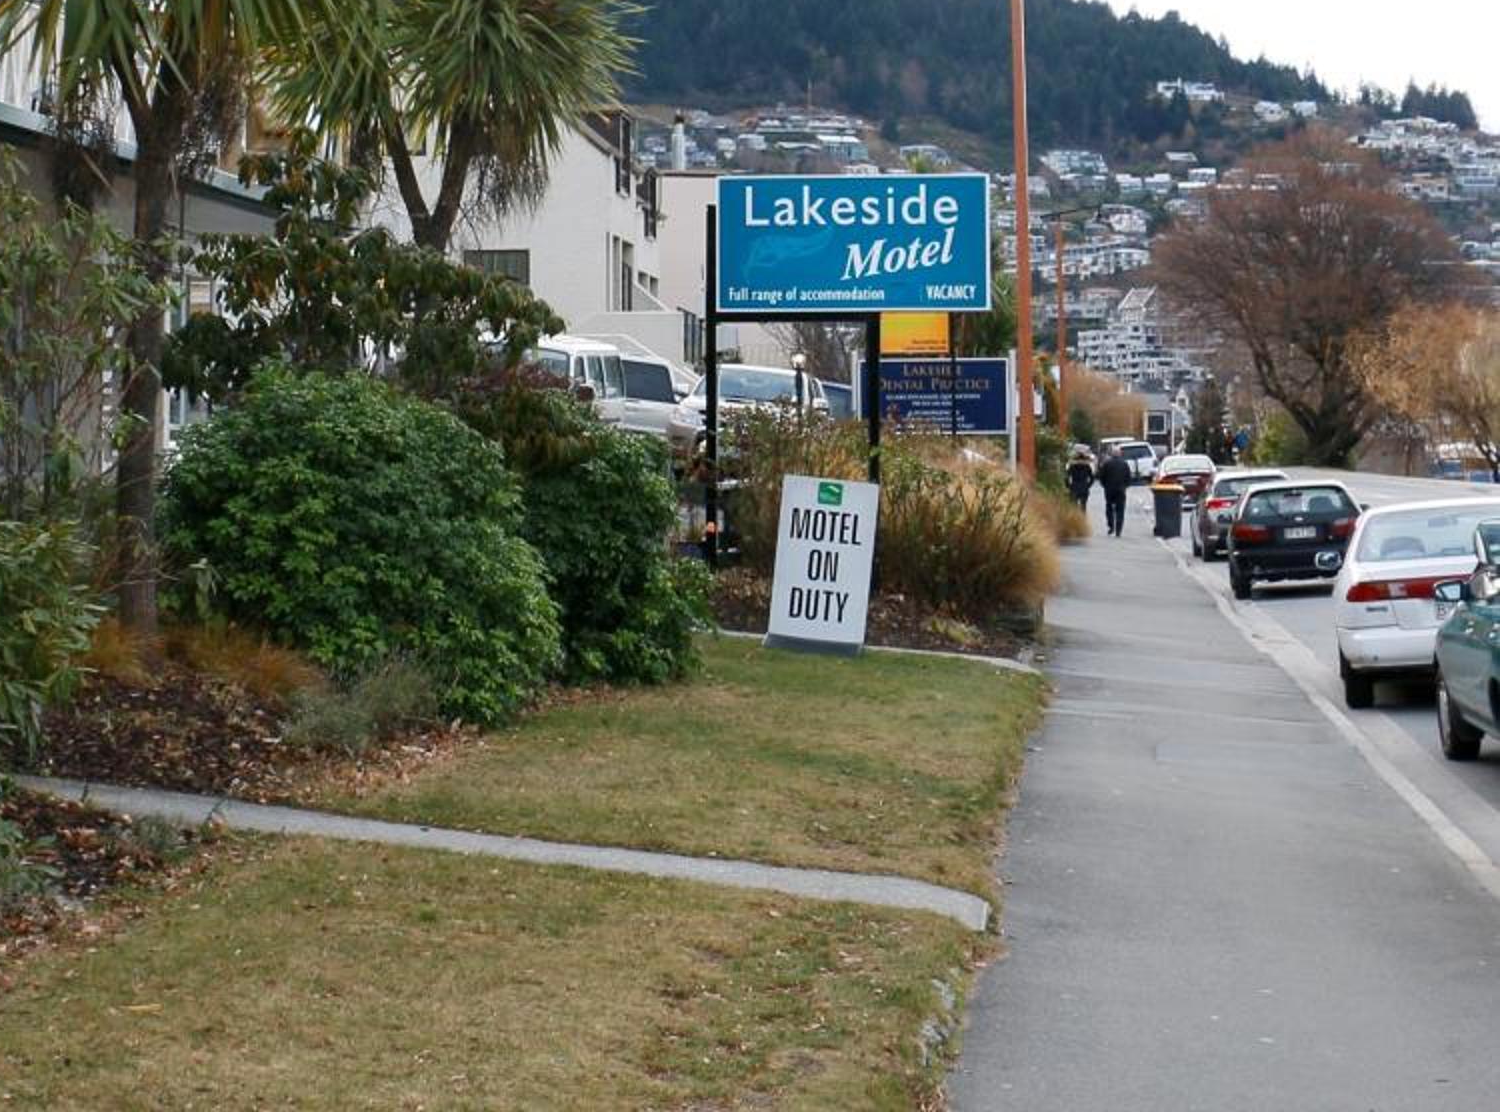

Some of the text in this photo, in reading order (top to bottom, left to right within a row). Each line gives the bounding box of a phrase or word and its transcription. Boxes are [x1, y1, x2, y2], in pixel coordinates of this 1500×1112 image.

[744, 184, 959, 226] Lakeside
[840, 227, 955, 280] Motel
[751, 289, 783, 305] range
[785, 286, 798, 301] of
[800, 286, 885, 301] accommodation
[926, 284, 976, 300] VACANCY
[789, 508, 862, 546] MOTEL
[807, 549, 839, 582] ON
[788, 587, 850, 623] DUTY
